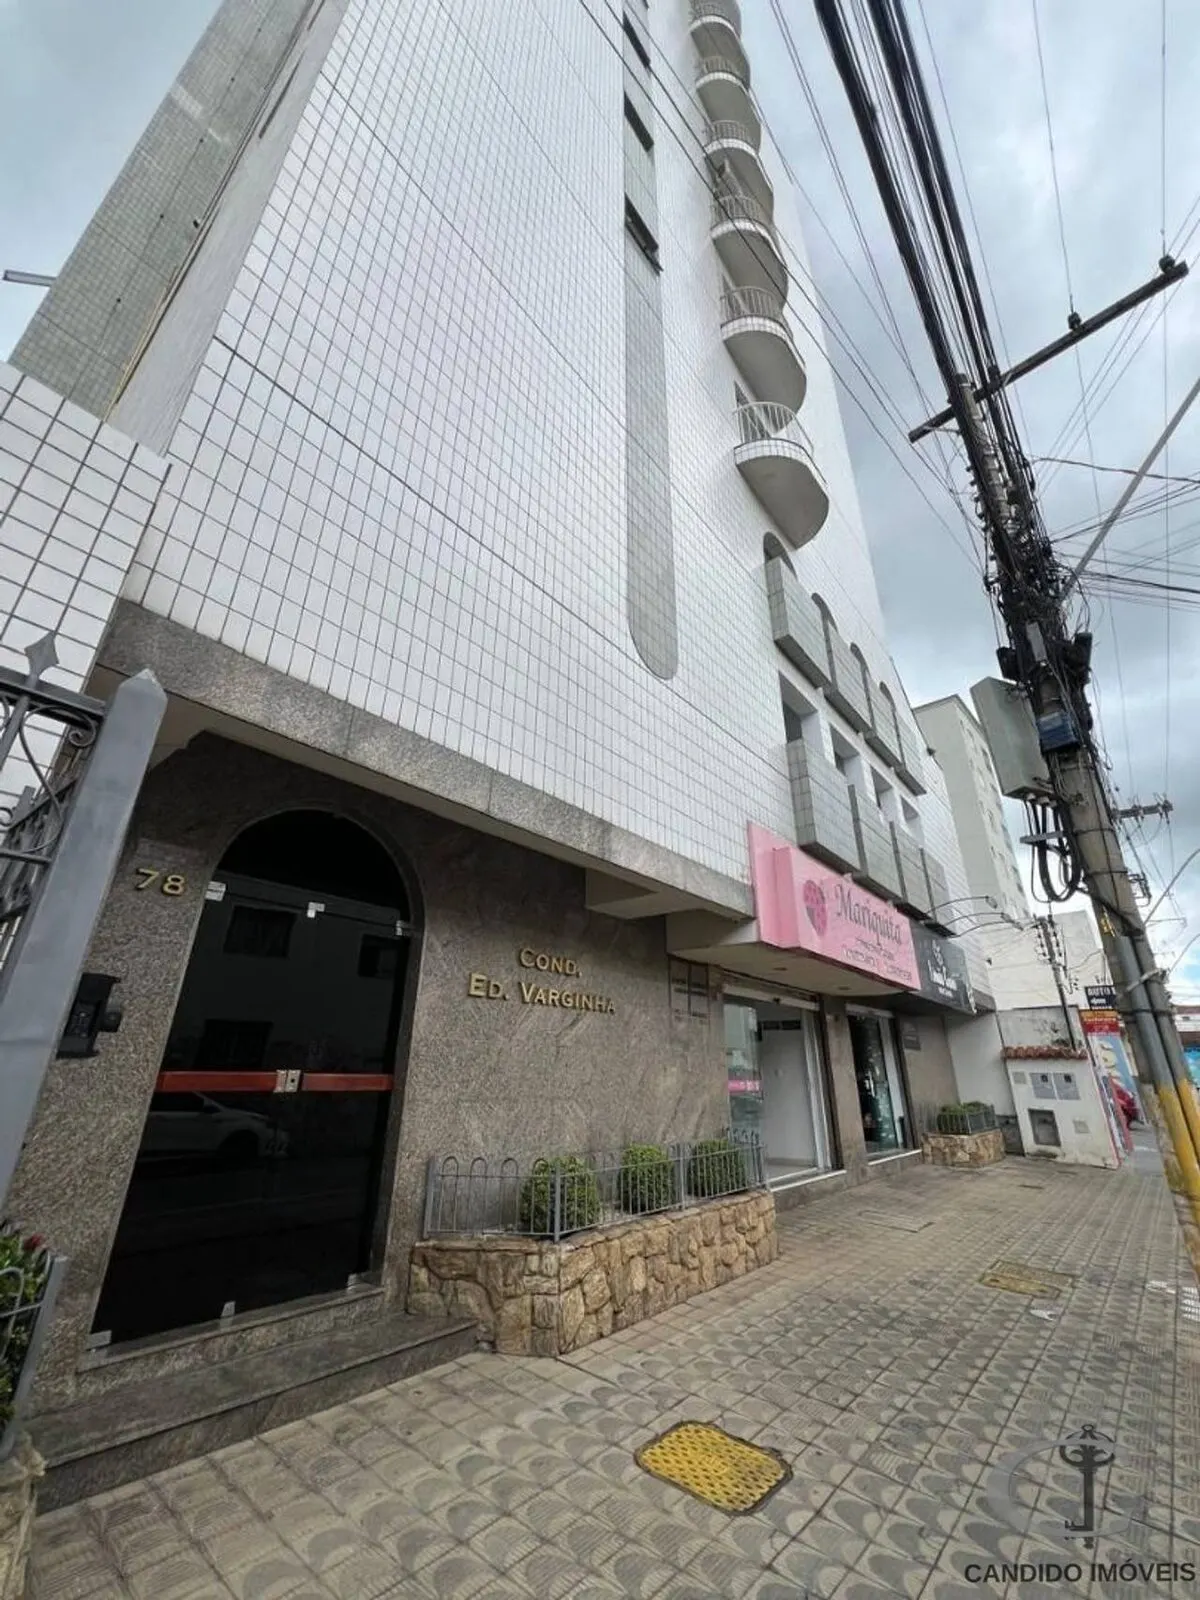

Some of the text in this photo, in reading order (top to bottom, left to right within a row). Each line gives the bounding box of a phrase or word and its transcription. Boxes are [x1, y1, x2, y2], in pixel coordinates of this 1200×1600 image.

[136, 868, 185, 896] 78
[519, 948, 582, 978] COND.
[468, 973, 616, 1015] ED. VARGINHA
